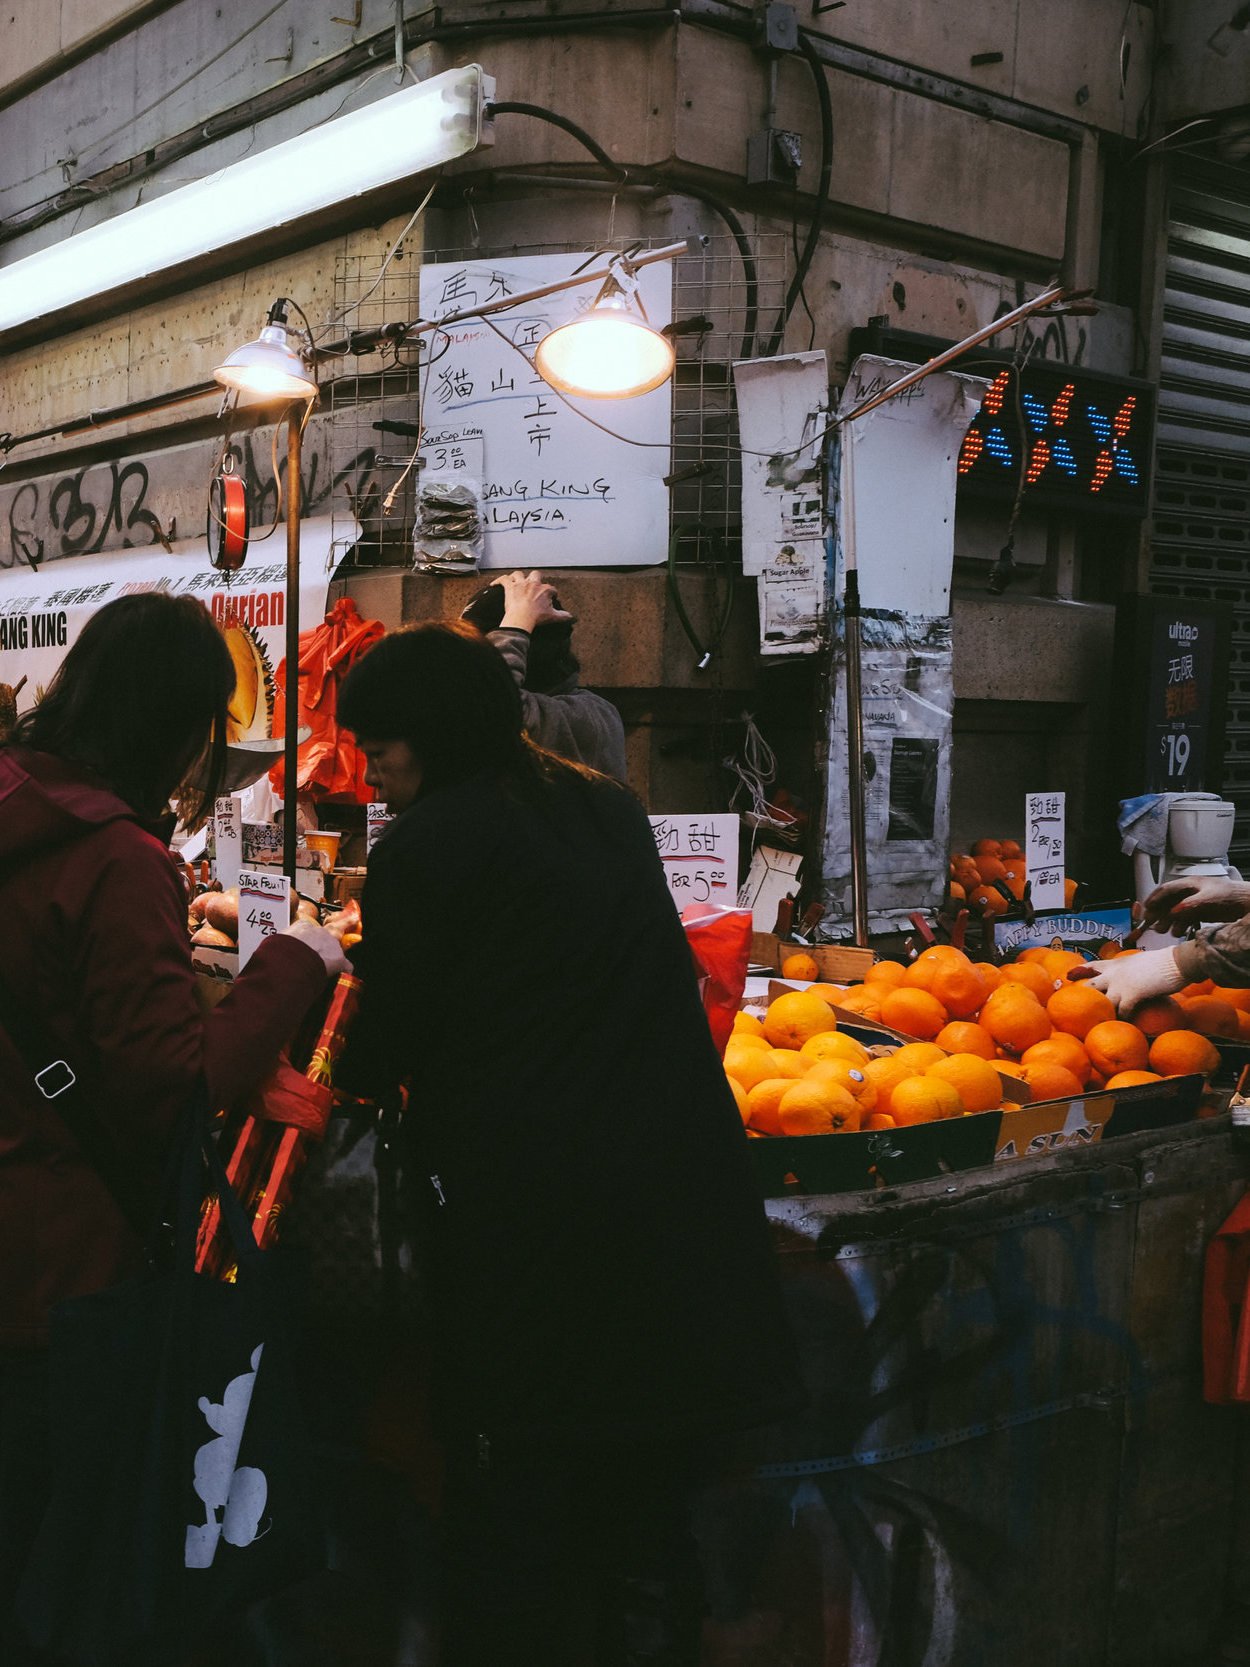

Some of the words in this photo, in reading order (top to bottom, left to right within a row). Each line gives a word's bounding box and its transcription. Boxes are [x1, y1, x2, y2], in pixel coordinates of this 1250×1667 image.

[453, 459, 467, 470] EA
[482, 479, 528, 502] SANG
[539, 477, 611, 504] KING
[769, 568, 789, 578] Sugar
[789, 565, 810, 577] Apple
[211, 587, 285, 630] Durian
[31, 610, 68, 648] KING
[1168, 654, 1194, 685] 无限
[1165, 680, 1198, 720] 数据
[1160, 733, 1191, 777] $19
[238, 874, 260, 889] STAR
[671, 873, 691, 889] FOR
[1046, 916, 1124, 949] BUDDHA
[1024, 1123, 1103, 1157] SUN
